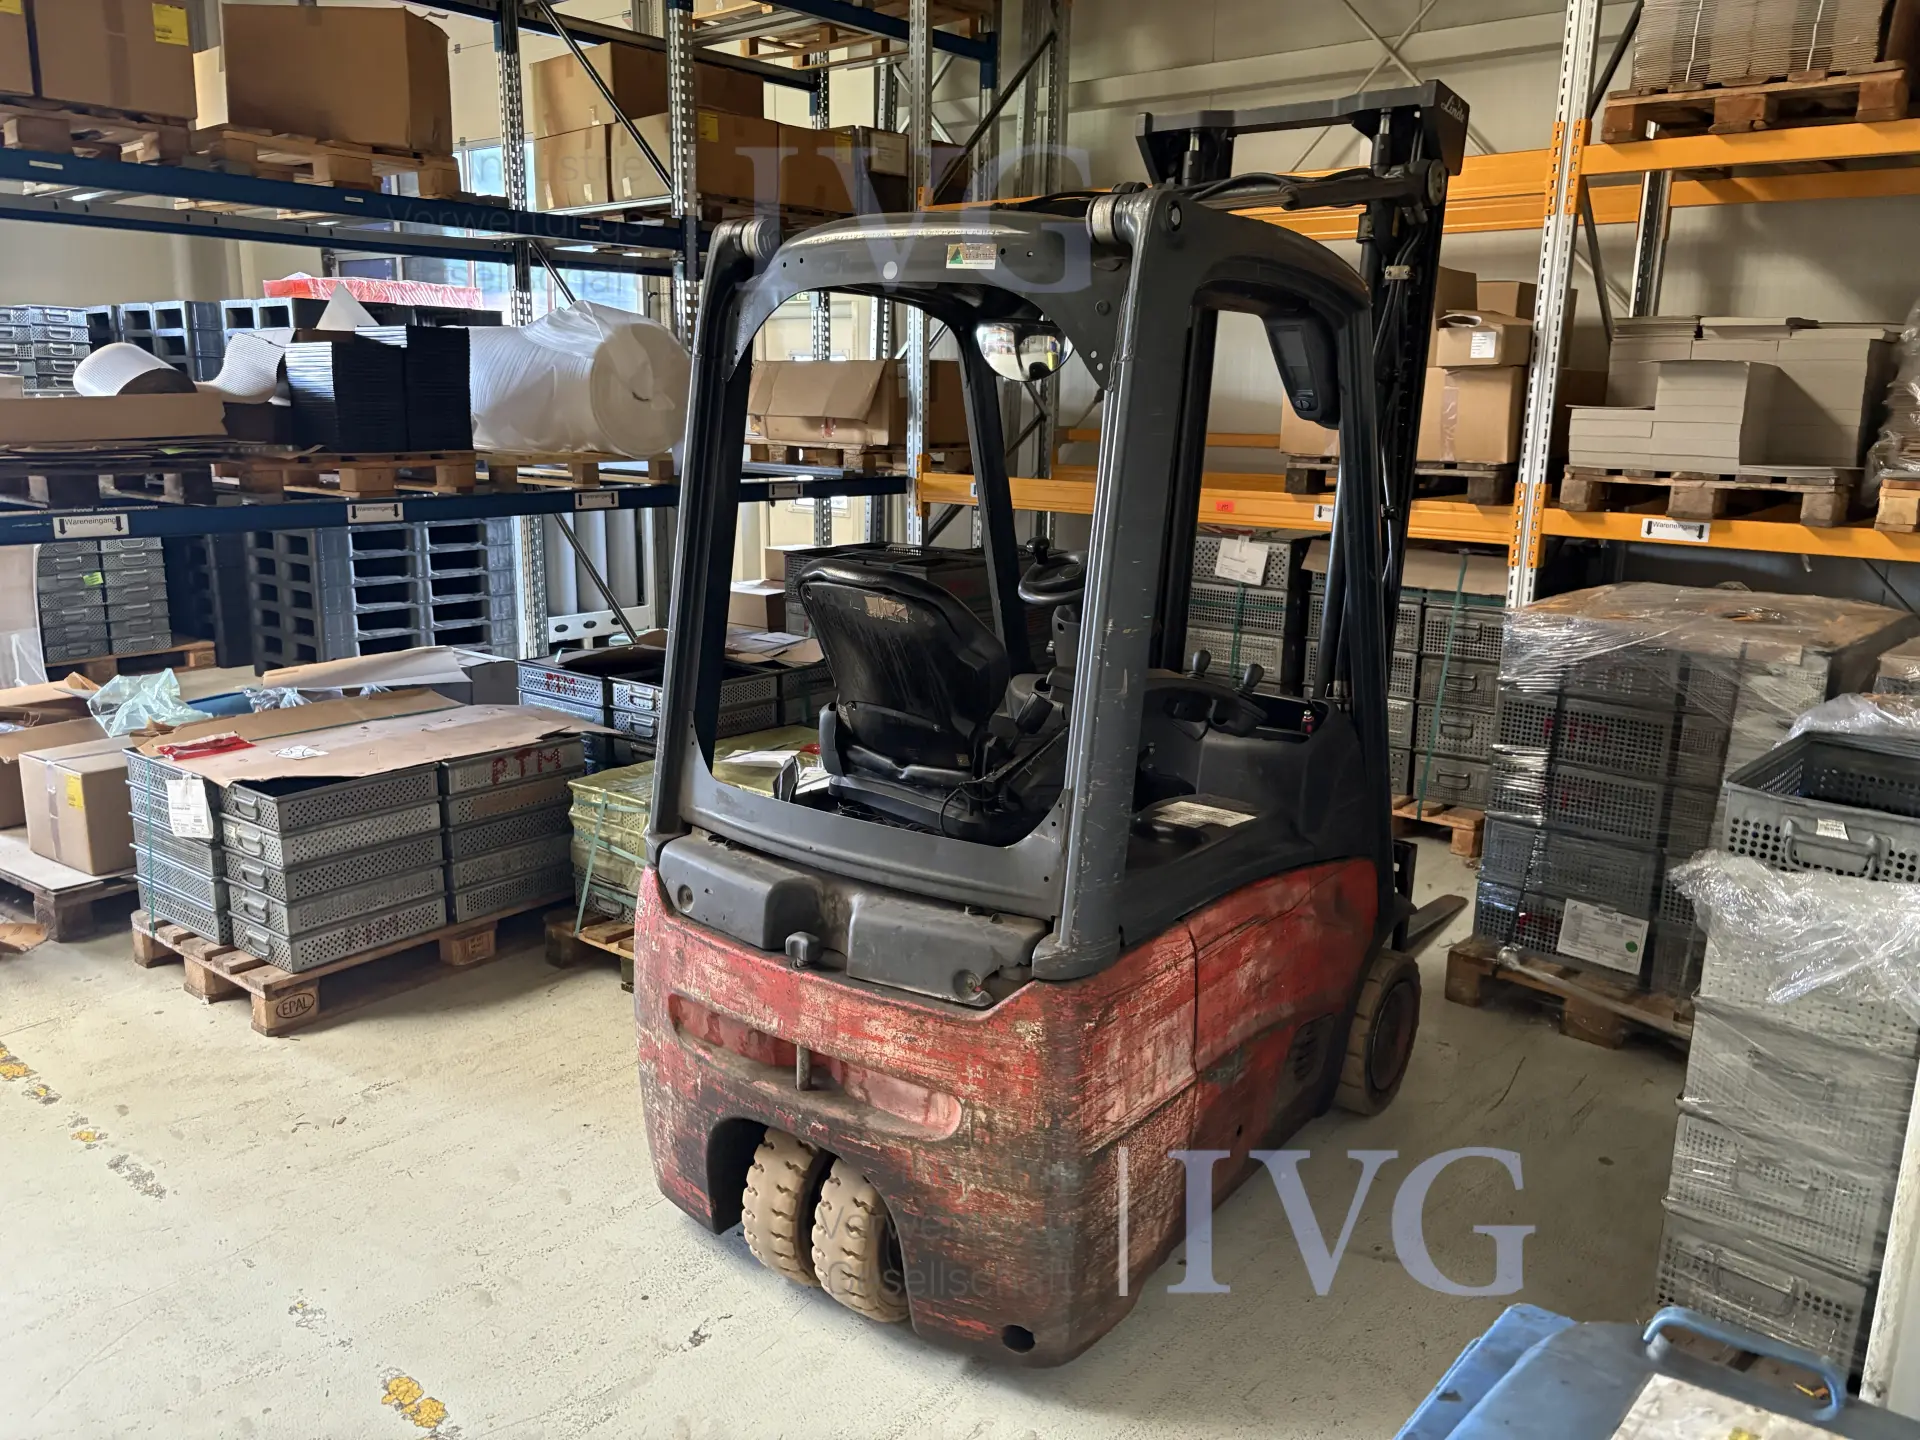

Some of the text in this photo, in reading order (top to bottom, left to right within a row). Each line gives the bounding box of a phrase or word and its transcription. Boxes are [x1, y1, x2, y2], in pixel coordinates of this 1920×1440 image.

[64, 517, 116, 526] Wareneingang
[1652, 521, 1700, 532] Wareneingang
[492, 748, 561, 785] PTM
[282, 996, 311, 1016] EPAL
